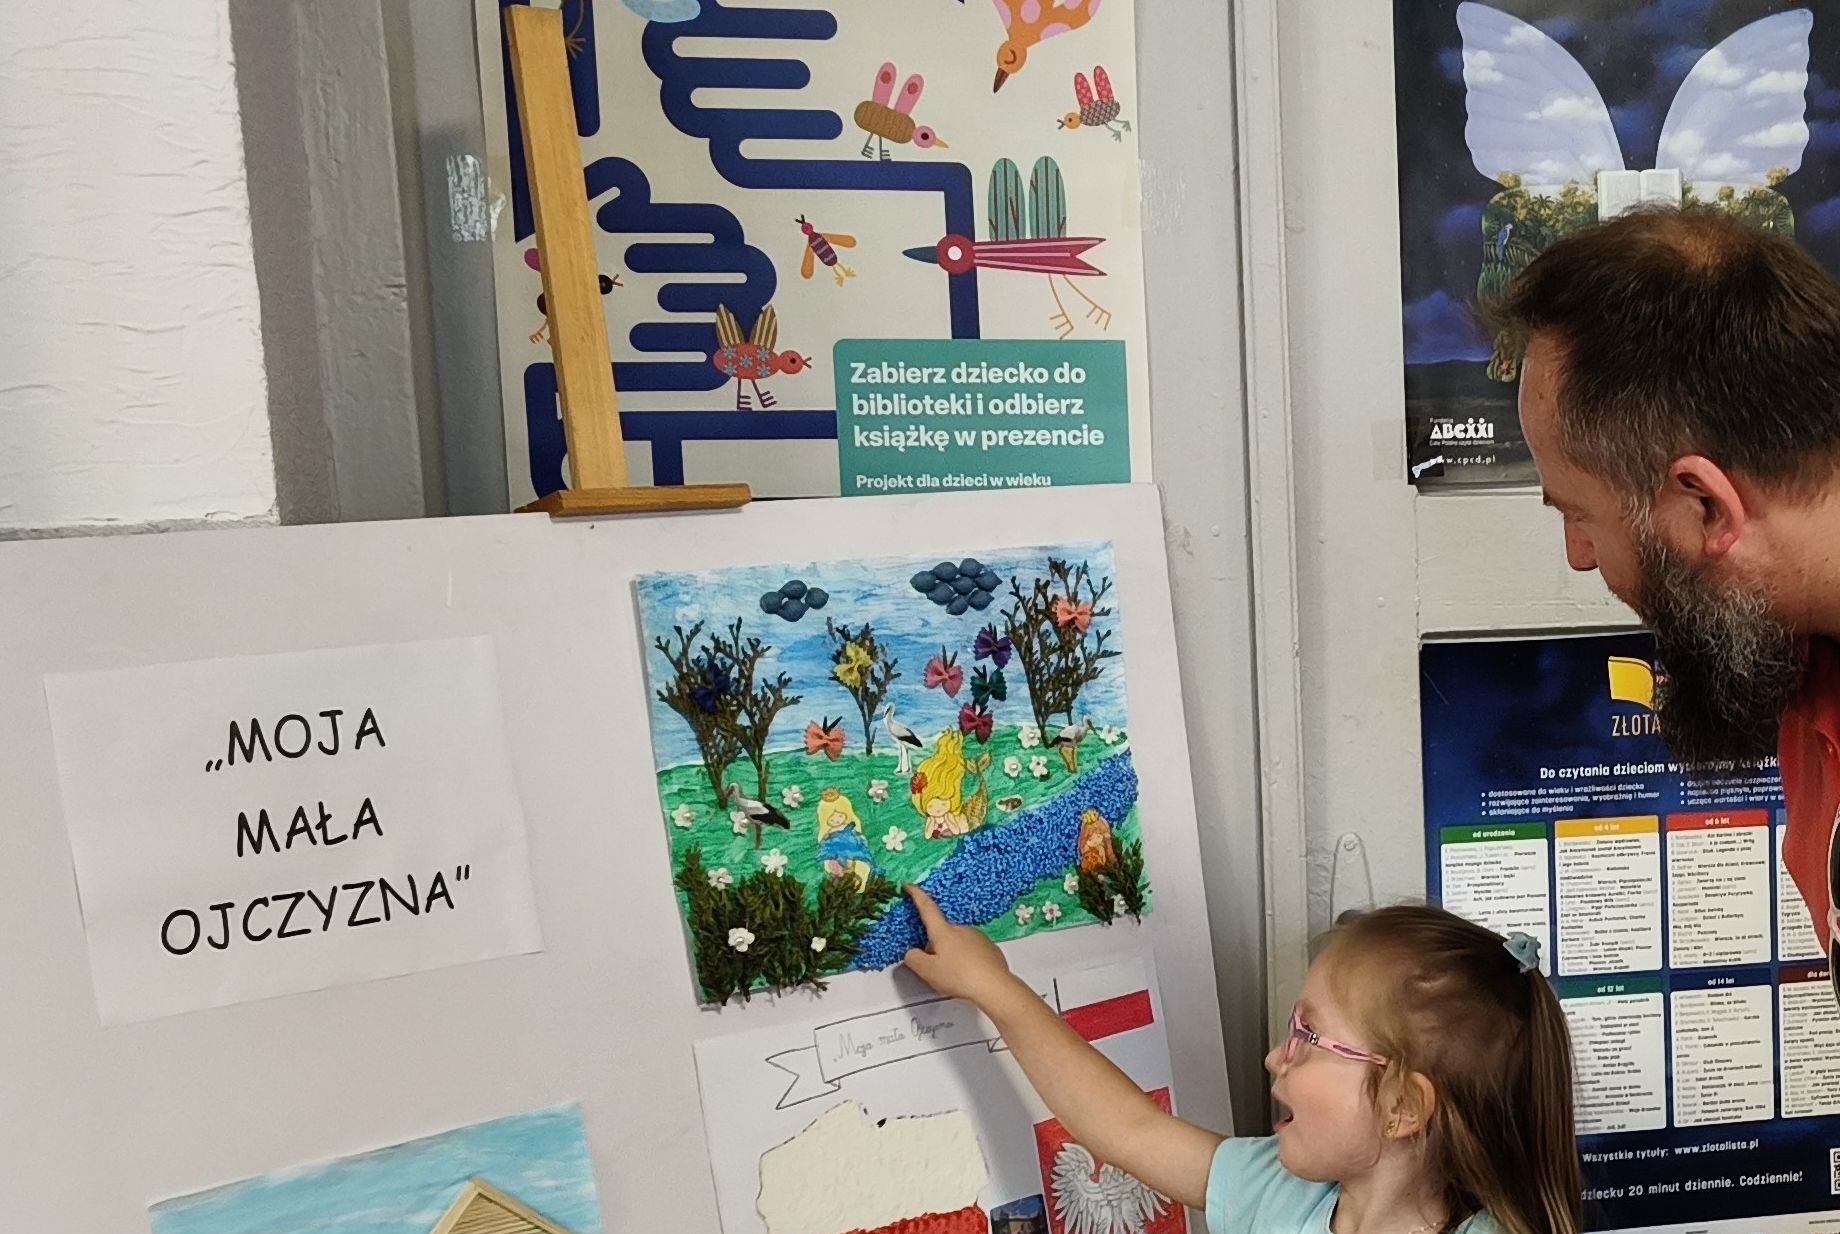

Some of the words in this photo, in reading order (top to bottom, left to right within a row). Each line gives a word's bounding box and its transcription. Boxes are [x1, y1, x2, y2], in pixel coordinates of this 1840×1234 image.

[850, 362, 946, 384] Zabierz
[951, 362, 1049, 384] dziecko
[1054, 362, 1086, 384] do
[852, 393, 971, 416] biblioteki
[977, 393, 983, 415] i
[988, 393, 1084, 416] odbierz
[854, 425, 950, 452] książkę
[955, 429, 977, 446] w
[982, 424, 1105, 450] prezencie
[857, 474, 914, 491] Projekt
[916, 474, 940, 488] dla
[943, 473, 988, 488] dzieci
[990, 476, 1003, 487] w
[1006, 473, 1051, 487] wieku
[1611, 714, 1661, 737] ZŁOTA
[205, 708, 386, 772] „MOJA
[1540, 767, 1555, 779] Do
[1559, 764, 1609, 779] czytania
[1613, 762, 1664, 775] dzieciom
[237, 797, 383, 857] MAŁA
[1705, 818, 1714, 826] od
[1707, 978, 1716, 987] od
[1582, 1151, 1634, 1163] Wszystkie
[1636, 1147, 1669, 1160] tytuły:
[1674, 1139, 1759, 1156] www.zlotalista.pl
[1581, 1188, 1624, 1201] dziecku
[1628, 1184, 1643, 1197] 20
[1648, 1181, 1680, 1195] minut
[1684, 1178, 1735, 1192] dziennie.
[1739, 1170, 1803, 1187] Codziennie!
